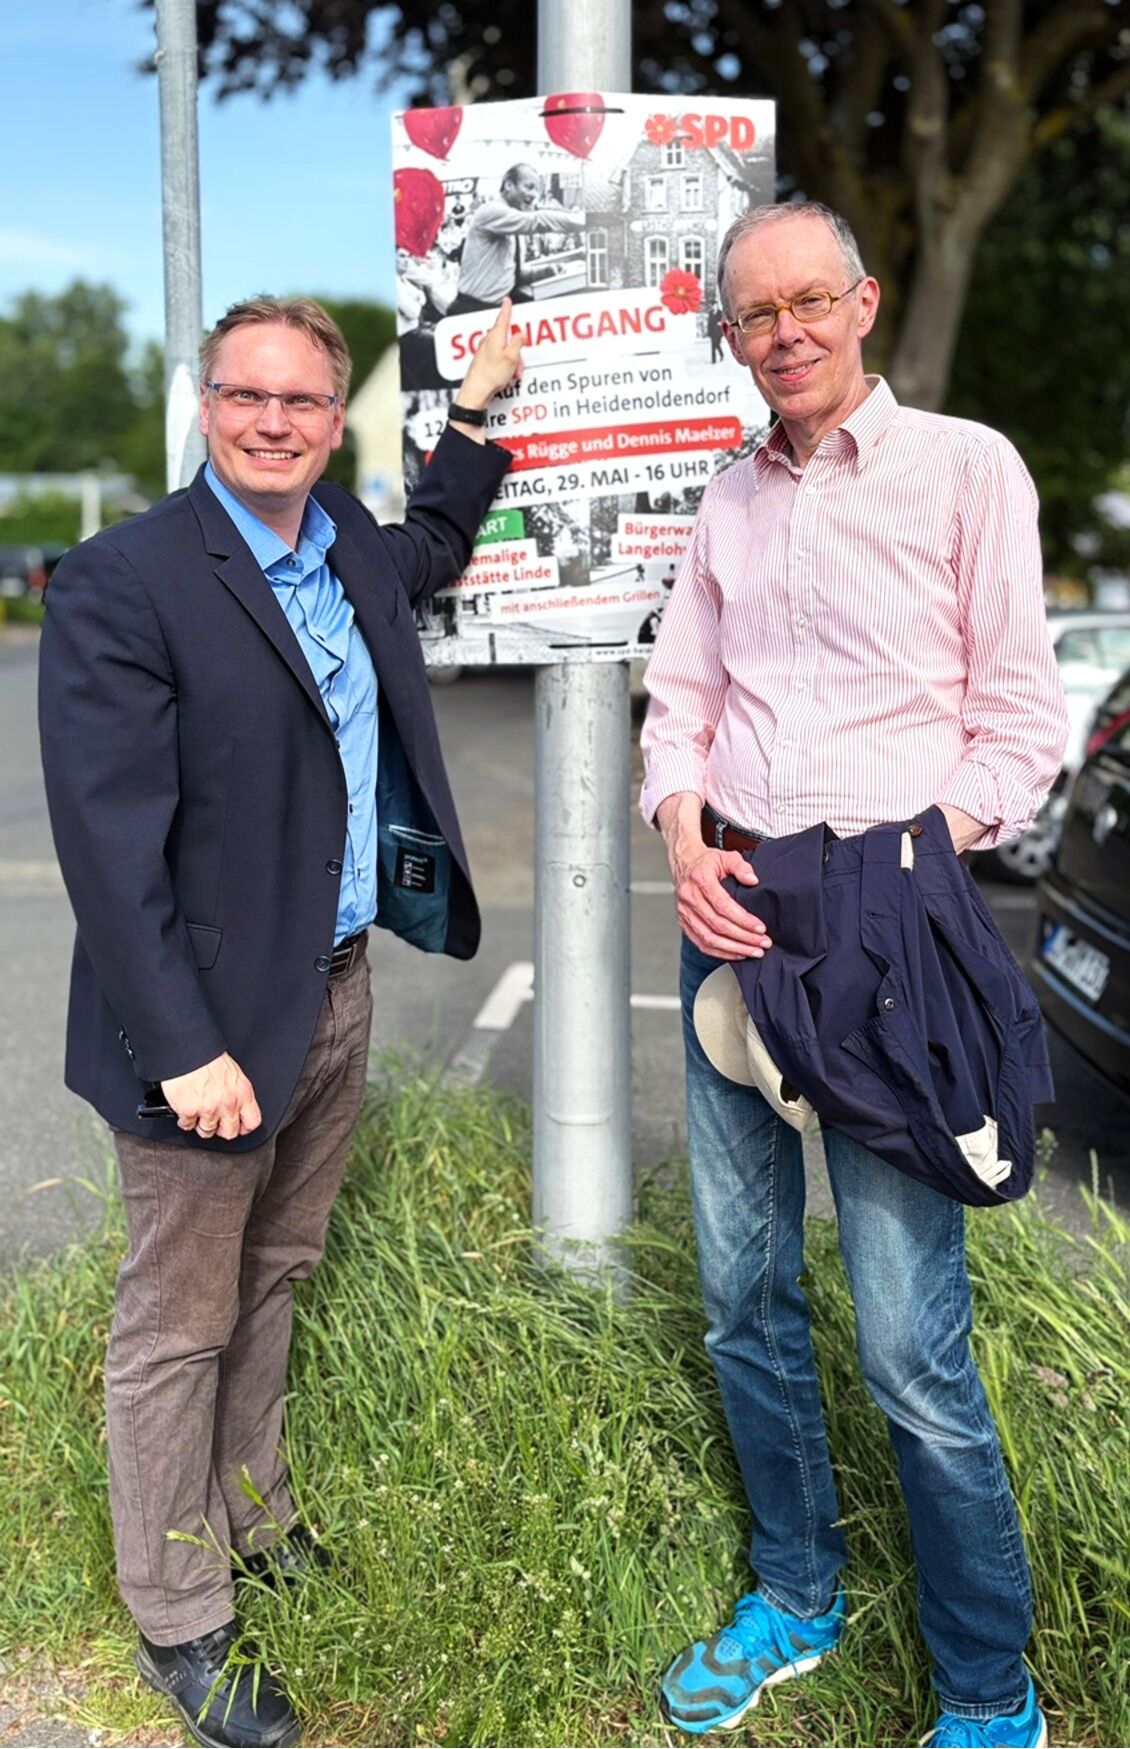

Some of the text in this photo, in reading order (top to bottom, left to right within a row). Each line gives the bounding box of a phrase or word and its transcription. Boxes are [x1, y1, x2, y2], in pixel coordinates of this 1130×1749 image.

[680, 112, 756, 150] SPD
[450, 305, 666, 361] SCNATGANG
[527, 377, 562, 396] den
[567, 370, 634, 394] Spuren
[638, 367, 673, 383] von
[424, 420, 444, 438] 12
[511, 403, 548, 424] SPD
[553, 401, 571, 418] in
[576, 385, 731, 416] Heidenoldendorf
[527, 440, 579, 461] Rügge
[582, 433, 614, 451] und
[616, 428, 673, 449] Dennis
[675, 424, 736, 444] Maelzer
[557, 473, 585, 492] 29.
[591, 467, 630, 488] MAI
[646, 464, 665, 481] 16
[670, 459, 709, 479] UHR
[475, 516, 508, 539] ART
[624, 522, 693, 540] Bürgerwa
[471, 549, 528, 565] emalige
[618, 541, 687, 560] Langeloh
[513, 565, 552, 581] Linde
[500, 590, 661, 614] mit anschließendem Grillen
